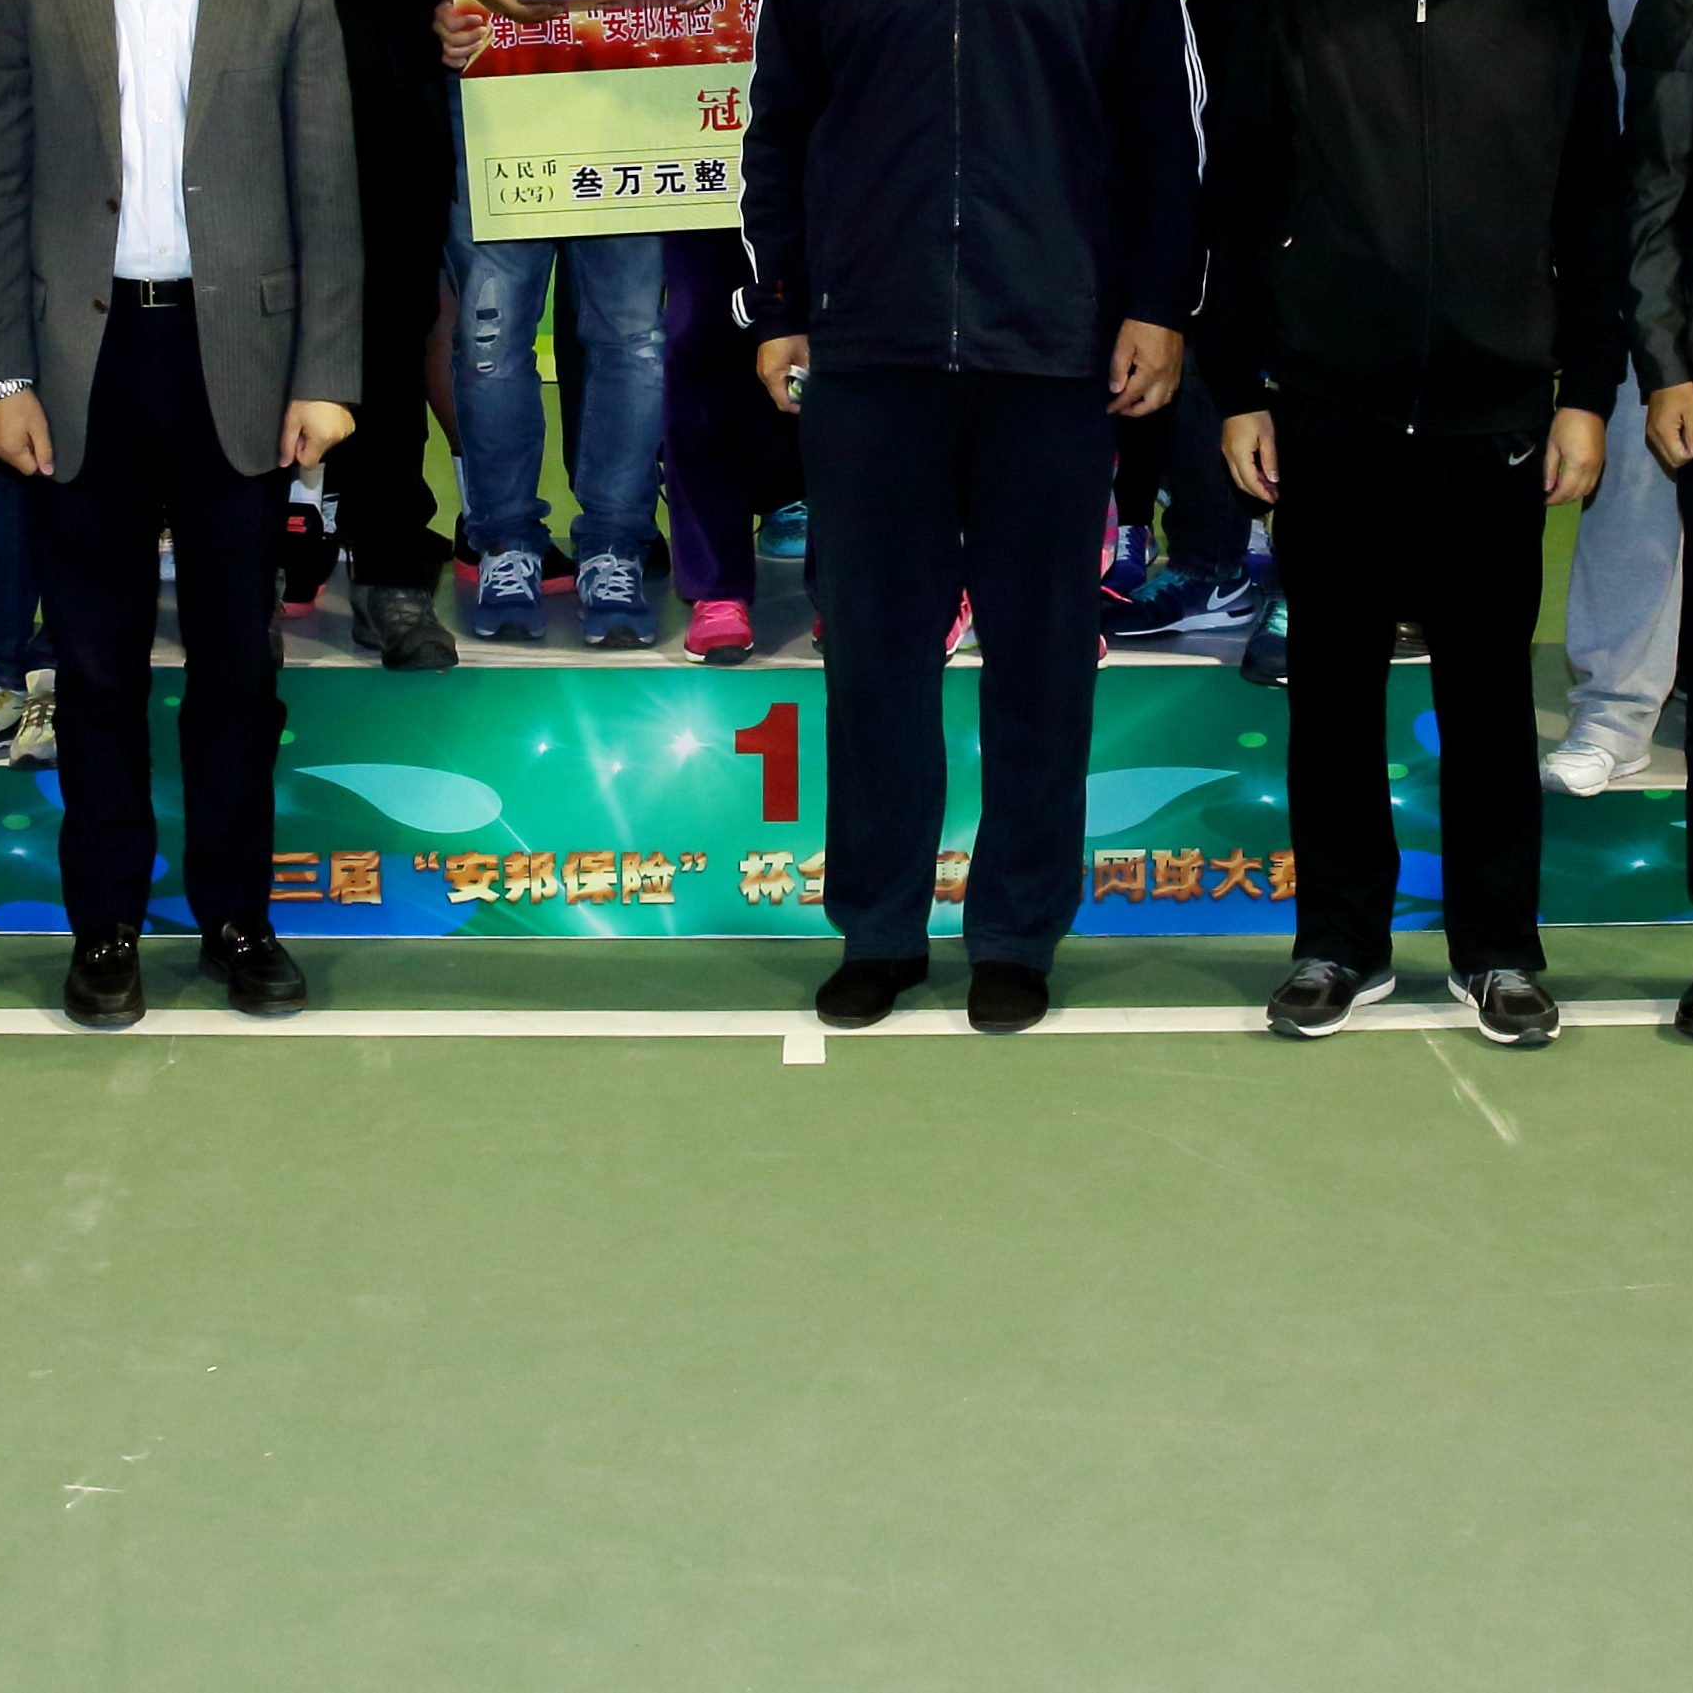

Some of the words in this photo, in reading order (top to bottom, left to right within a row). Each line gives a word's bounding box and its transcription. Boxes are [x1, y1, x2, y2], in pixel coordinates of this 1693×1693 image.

[697, 87, 743, 131] 冠
[493, 159, 557, 179] 人民币
[571, 159, 728, 200] 叁万元整
[735, 703, 799, 822] 1
[413, 850, 707, 905] “安邦保险”
